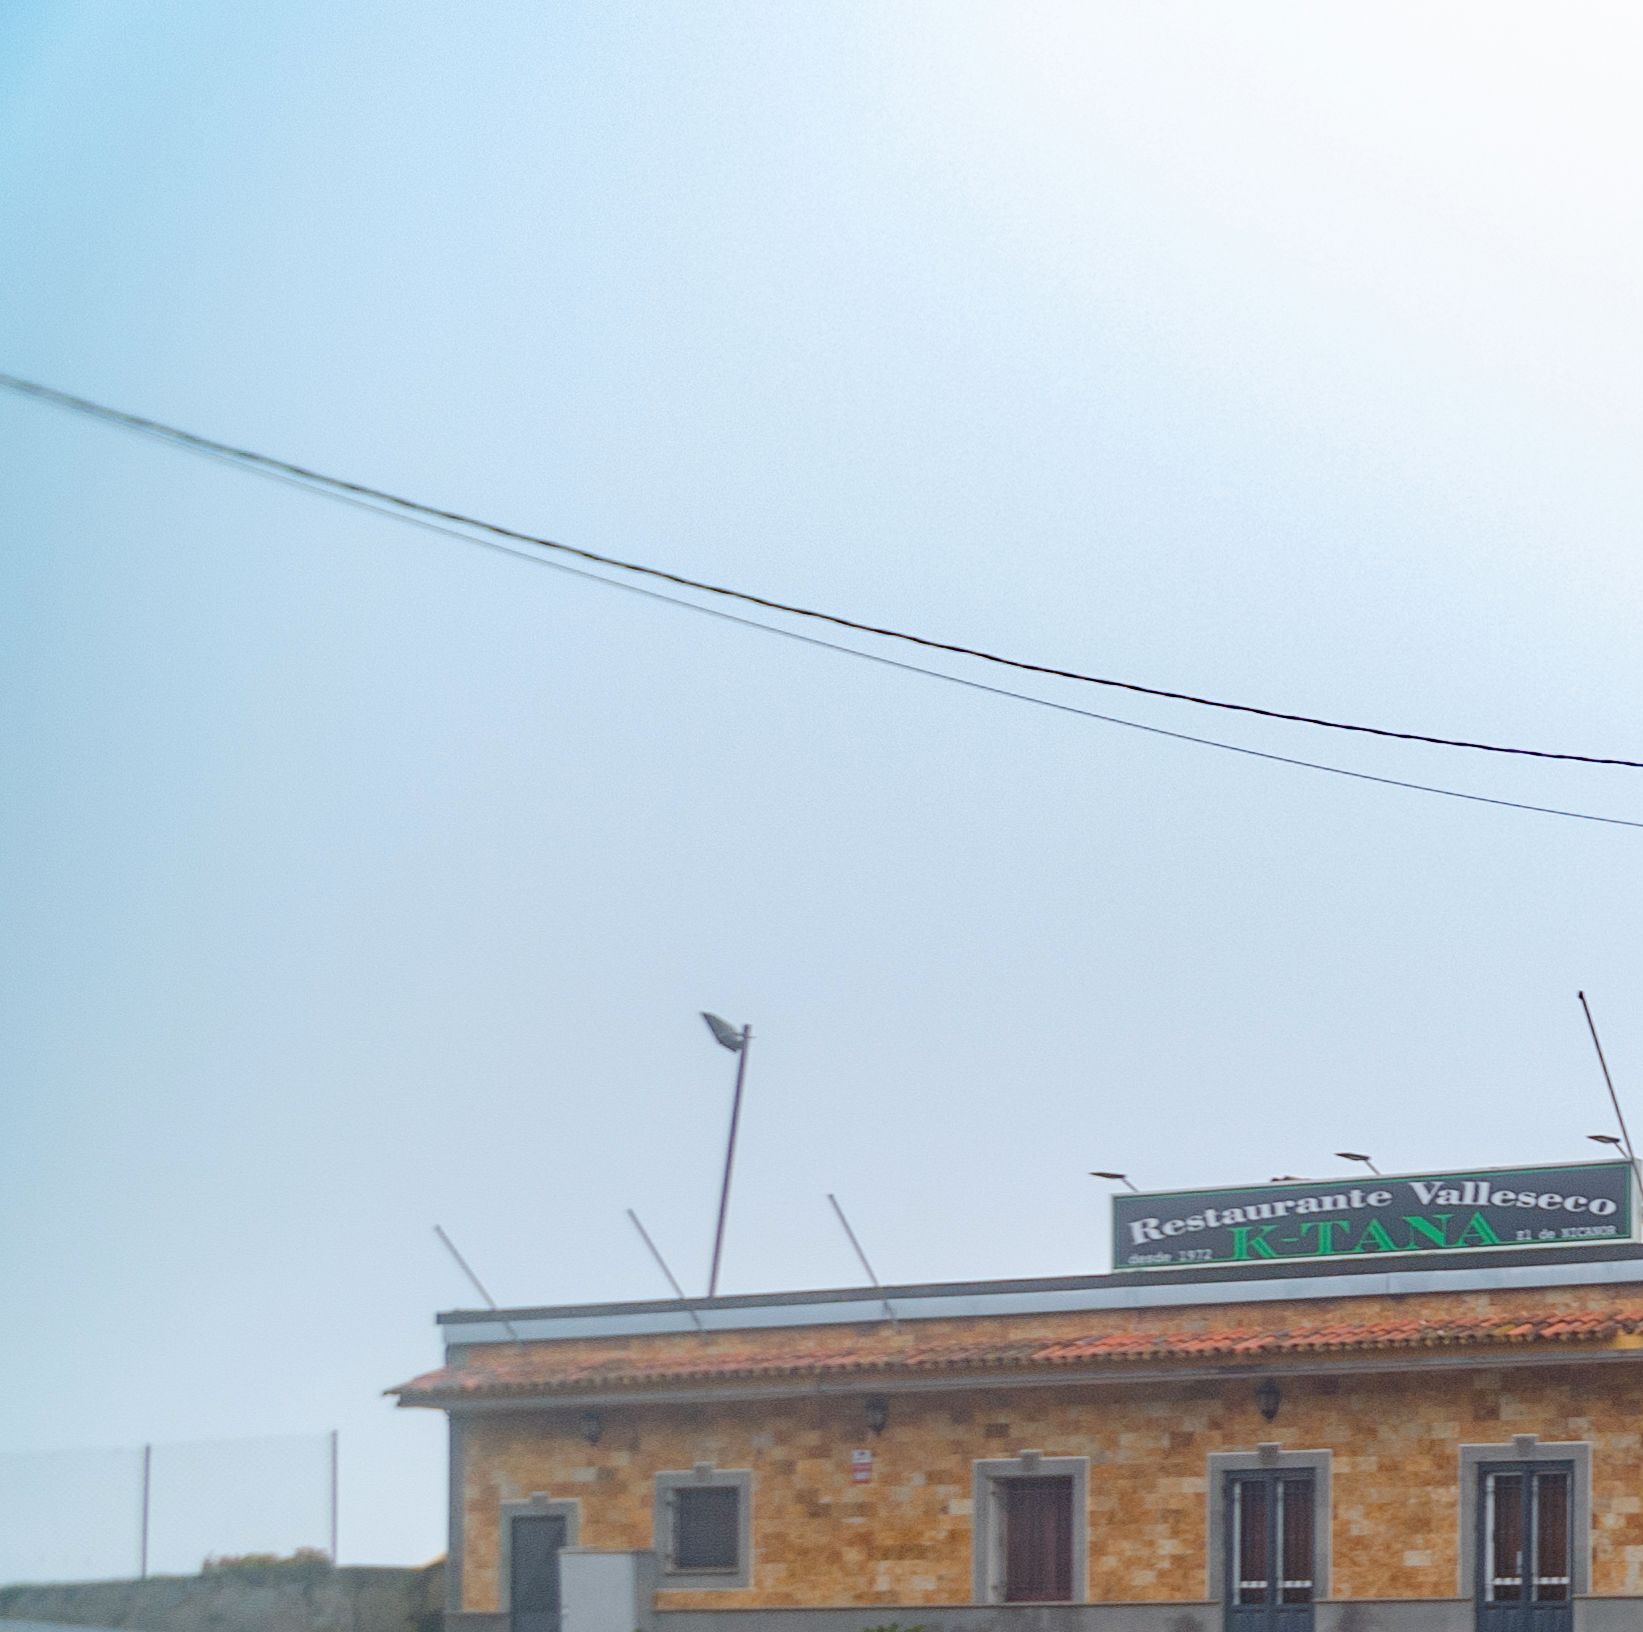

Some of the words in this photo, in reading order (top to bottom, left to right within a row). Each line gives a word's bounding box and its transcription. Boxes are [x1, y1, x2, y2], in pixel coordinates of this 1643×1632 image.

[1128, 1187, 1392, 1245] Restaurante
[1410, 1181, 1617, 1216] Valleseco
[1227, 1211, 1501, 1261] K-TANA
